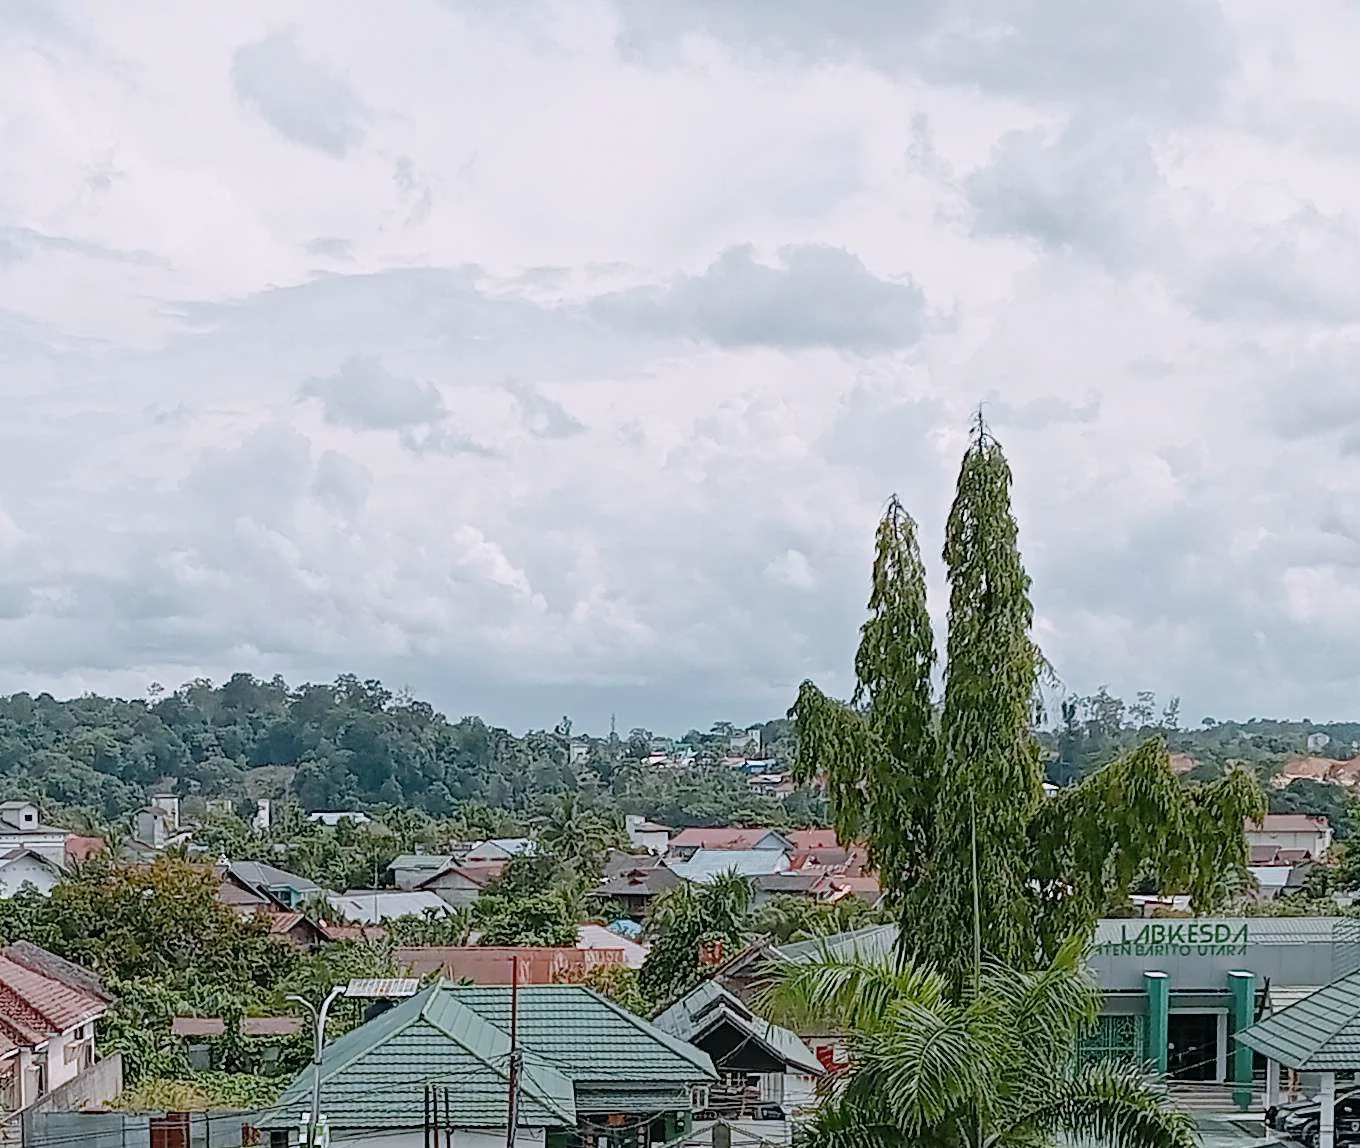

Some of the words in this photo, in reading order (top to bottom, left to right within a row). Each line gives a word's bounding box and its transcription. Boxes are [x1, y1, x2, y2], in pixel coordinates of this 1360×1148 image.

[1121, 923, 1249, 945] LABKESDA
[1135, 944, 1190, 957] BARITO
[1197, 944, 1248, 957] UTARA
